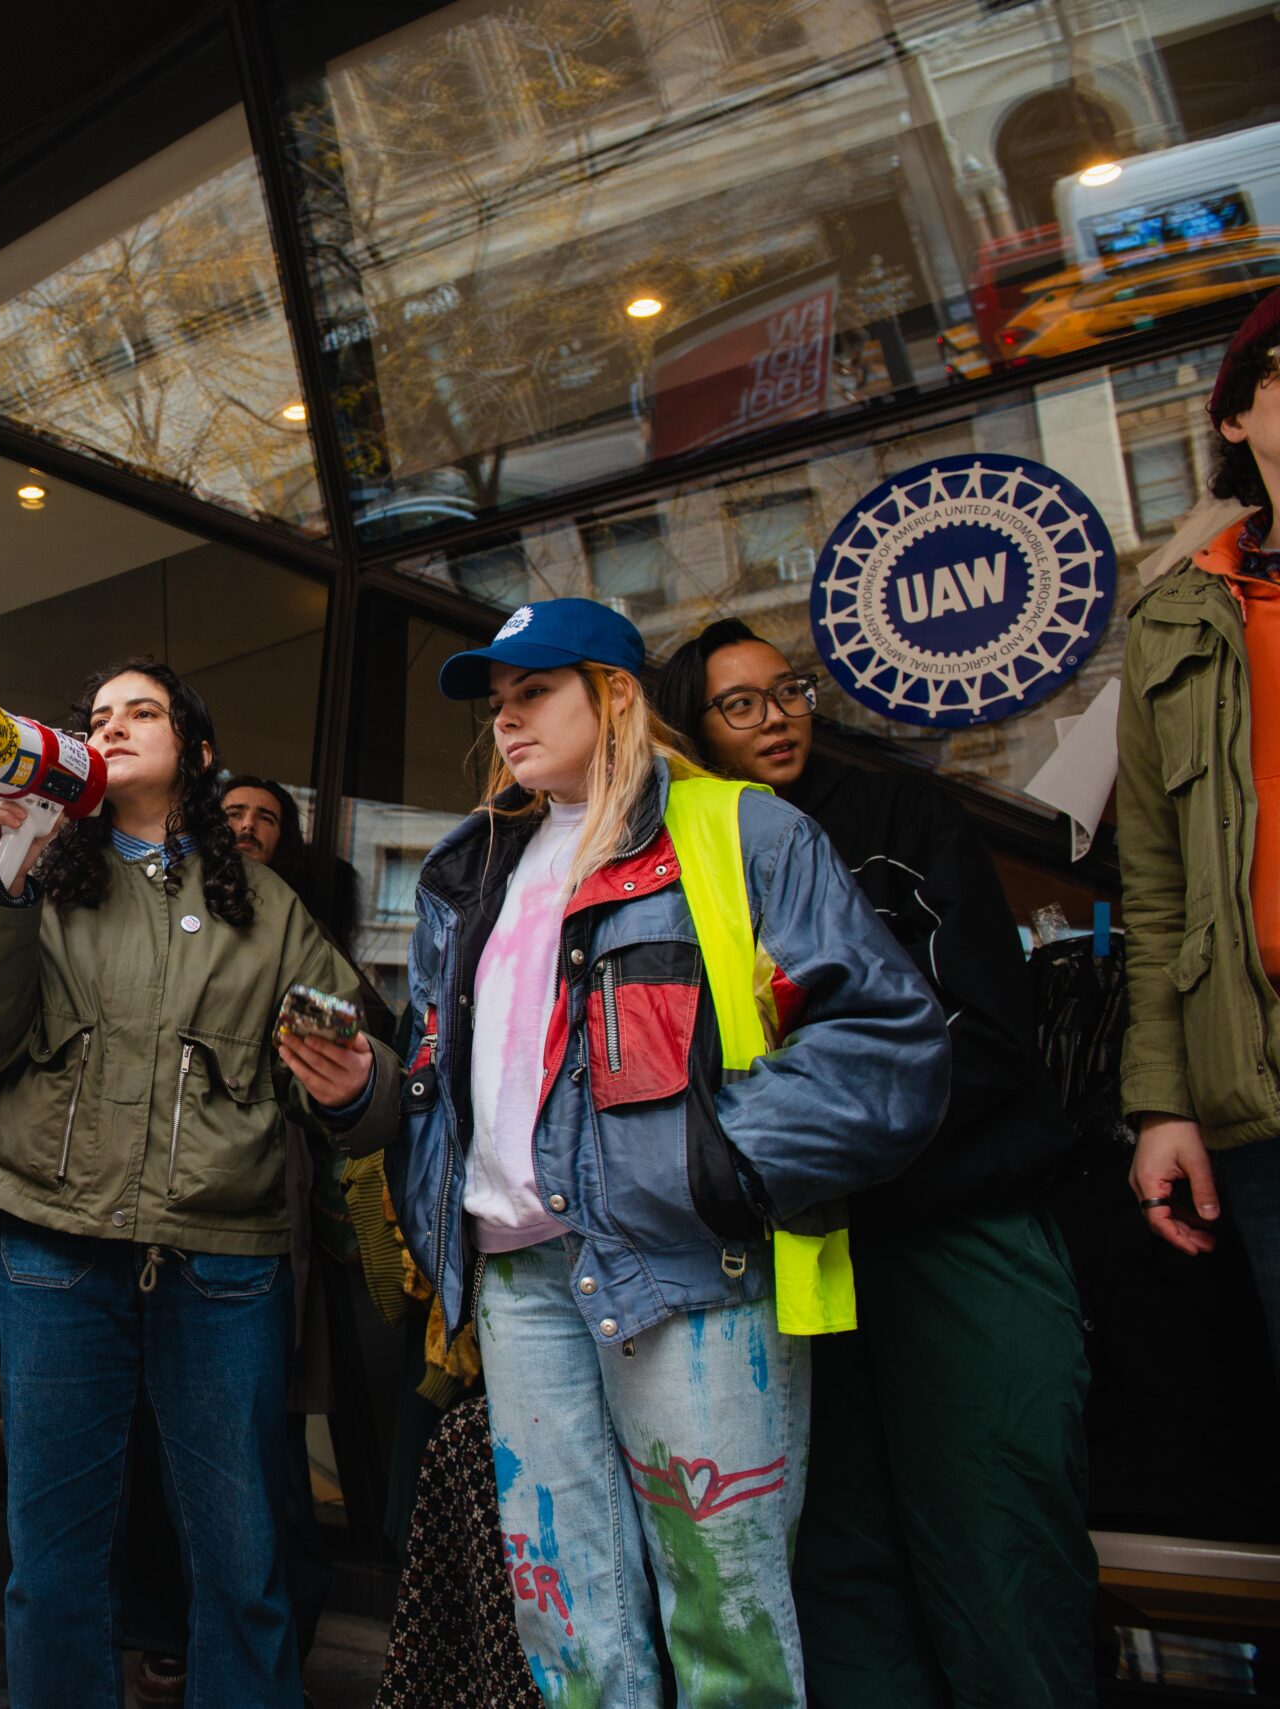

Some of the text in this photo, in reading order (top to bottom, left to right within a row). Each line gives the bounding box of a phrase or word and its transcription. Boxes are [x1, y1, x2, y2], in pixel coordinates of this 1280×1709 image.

[891, 510, 943, 543] AMERICA
[944, 504, 991, 518] UNITED
[879, 542, 893, 559] OF
[863, 558, 884, 610] WORKERS
[896, 551, 1007, 624] UAW
[1023, 568, 1052, 634] AEROSPACE
[867, 613, 907, 663] IMPLEMENT
[999, 631, 1026, 656] AND
[908, 652, 999, 675] AGRICULTURAL
